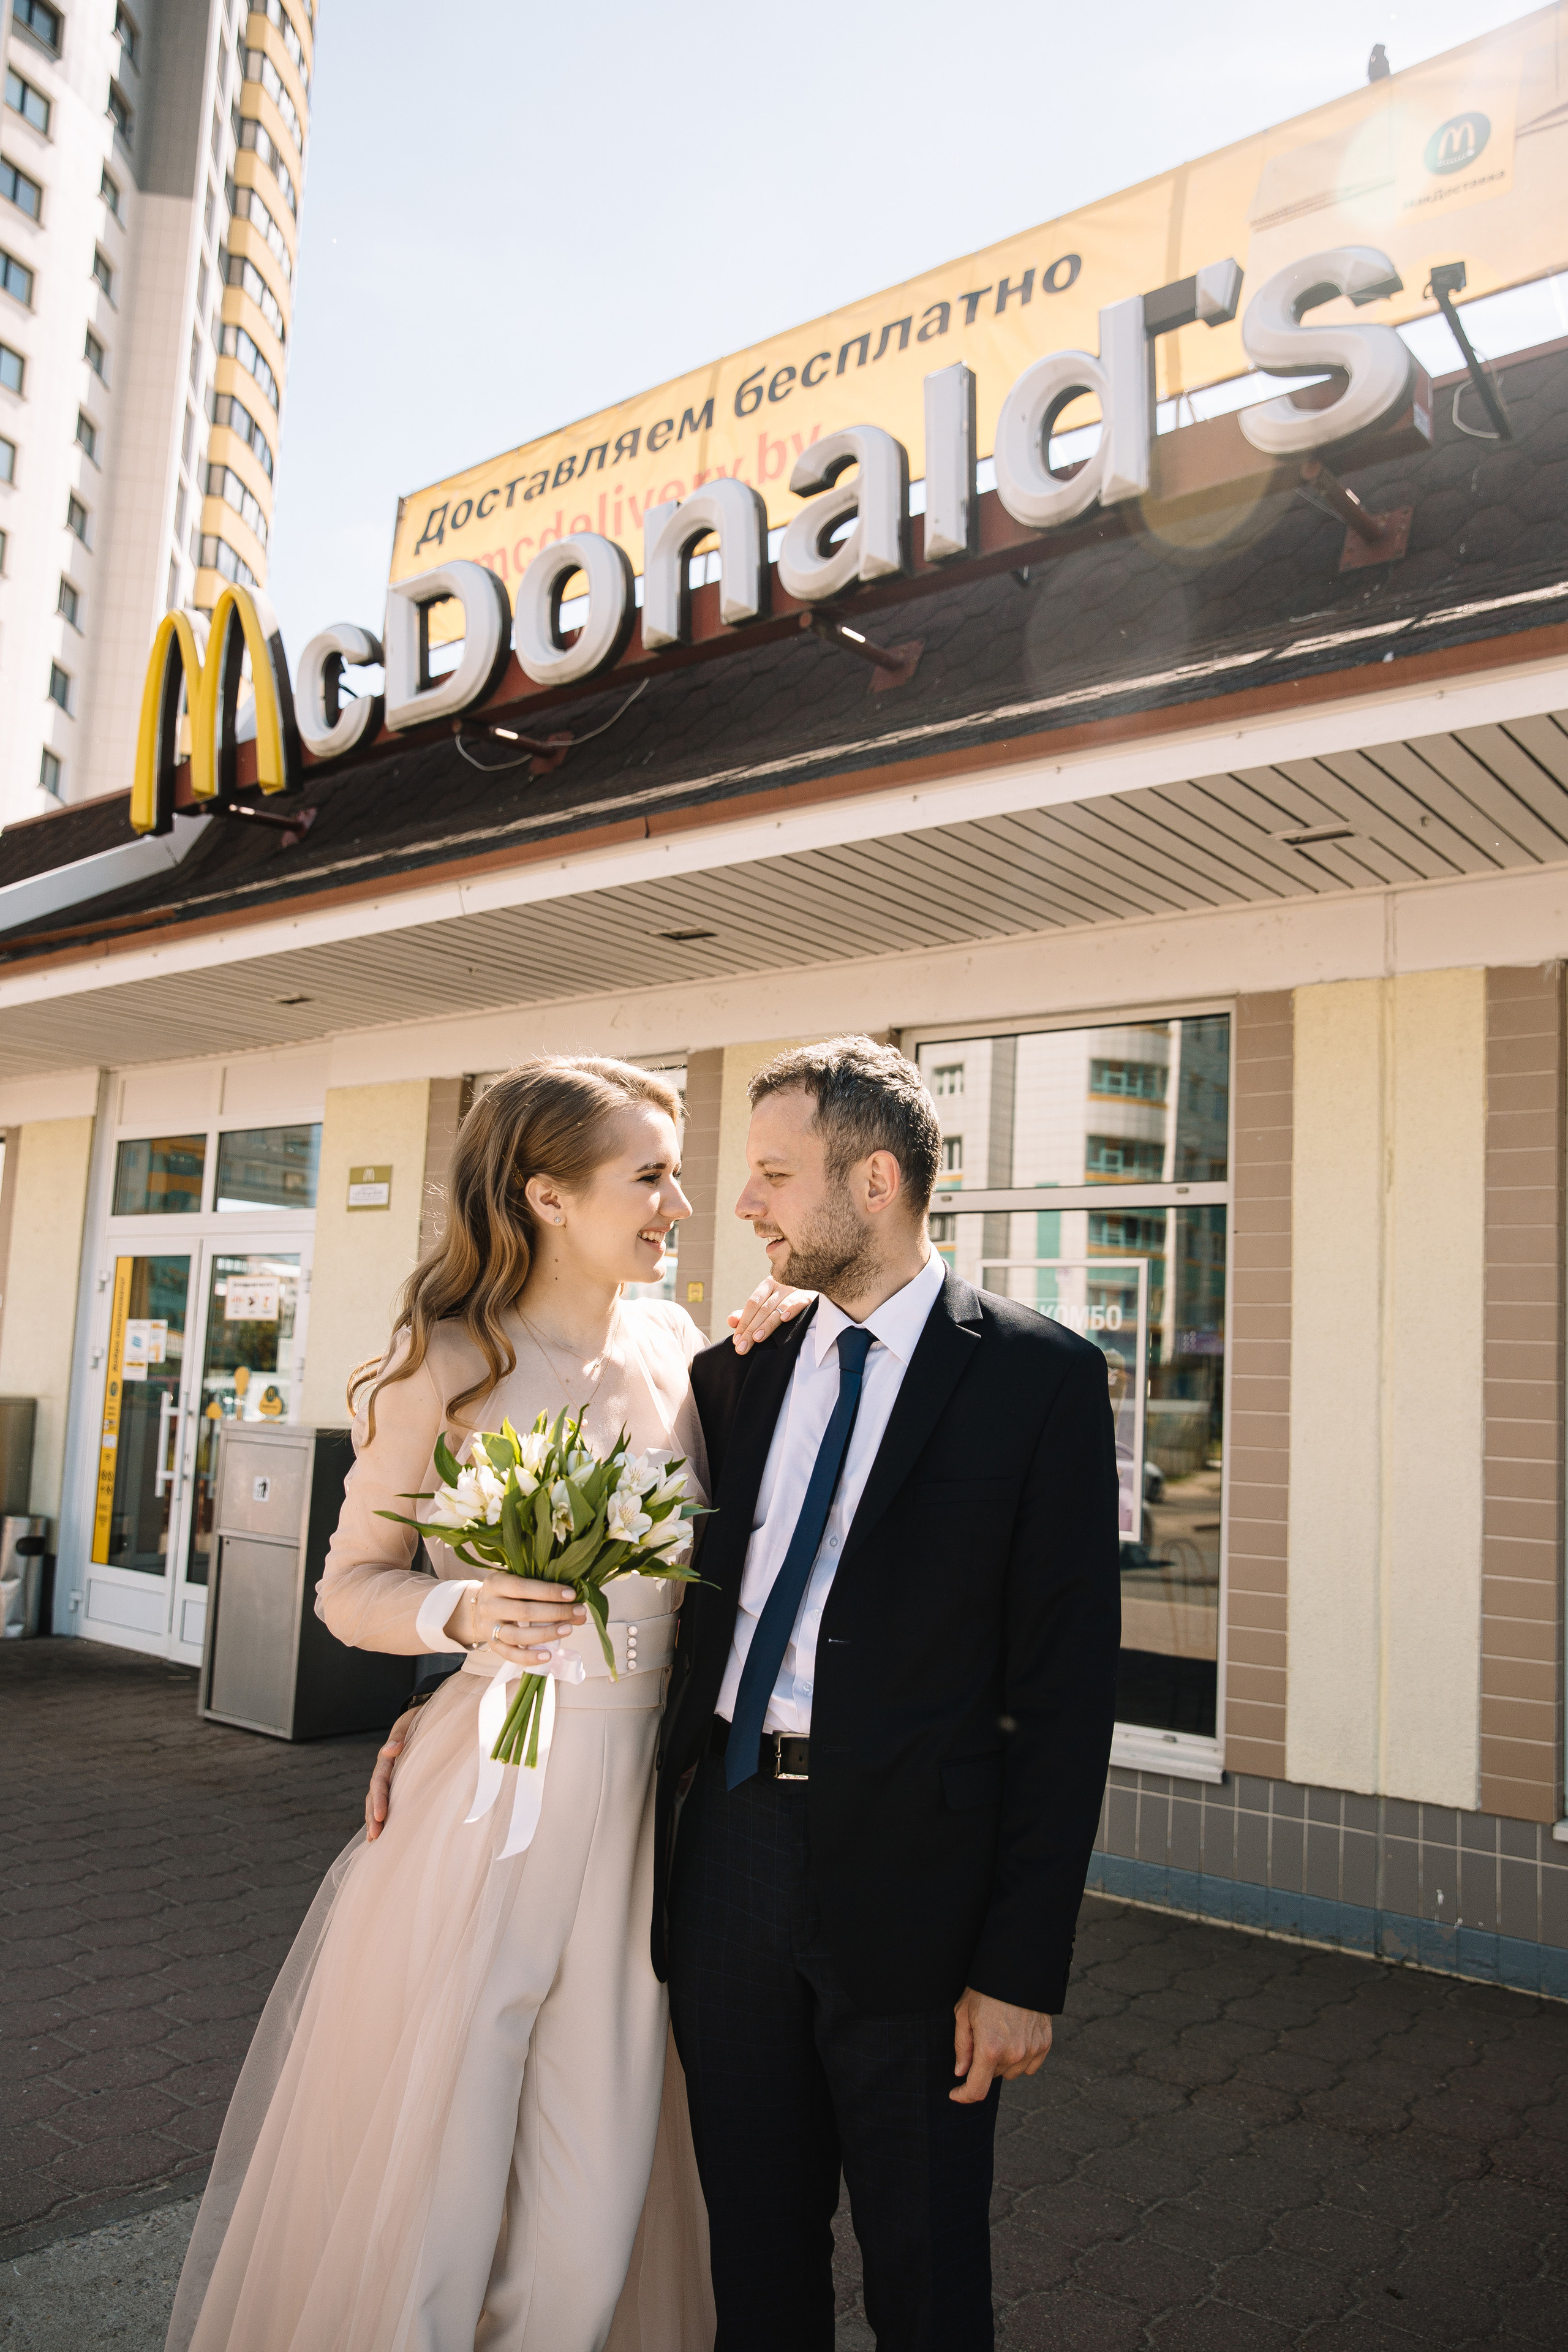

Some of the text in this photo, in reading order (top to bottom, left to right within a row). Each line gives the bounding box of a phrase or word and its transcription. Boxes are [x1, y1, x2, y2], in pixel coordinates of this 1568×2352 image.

[130, 246, 1412, 835] McDonald's
[415, 254, 1082, 556] Доставляем бесплатно
